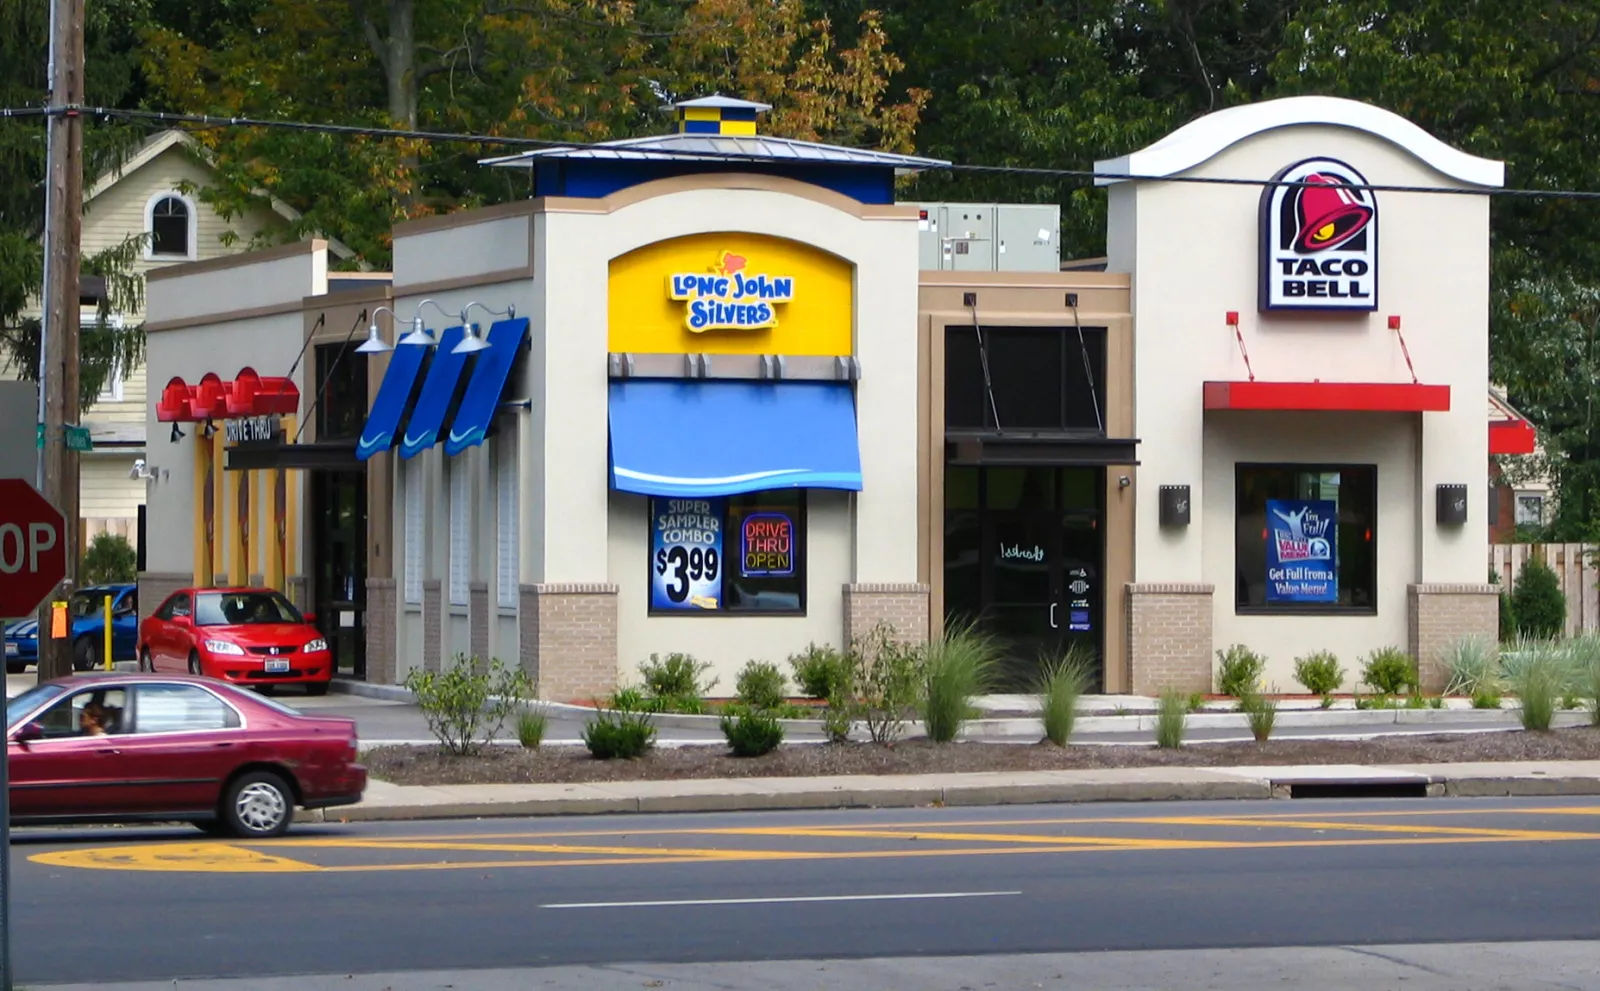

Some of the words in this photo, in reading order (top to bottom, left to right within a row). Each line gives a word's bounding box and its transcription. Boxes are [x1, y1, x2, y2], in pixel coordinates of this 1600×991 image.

[1276, 258, 1369, 276] TACO
[1282, 280, 1370, 298] BELL
[250, 419, 271, 441] THRU
[668, 500, 710, 515] SUPER
[658, 515, 719, 532] SAMPLER
[745, 522, 789, 538] DRIVE
[663, 529, 715, 545] COMBO
[0, 522, 57, 574] OP
[746, 538, 789, 553] THRU
[746, 553, 789, 569] OPEN
[1269, 568, 1285, 581] Get
[1286, 567, 1303, 580] Full
[1304, 567, 1327, 581] from
[1327, 571, 1334, 580] a
[1275, 582, 1300, 594] Value
